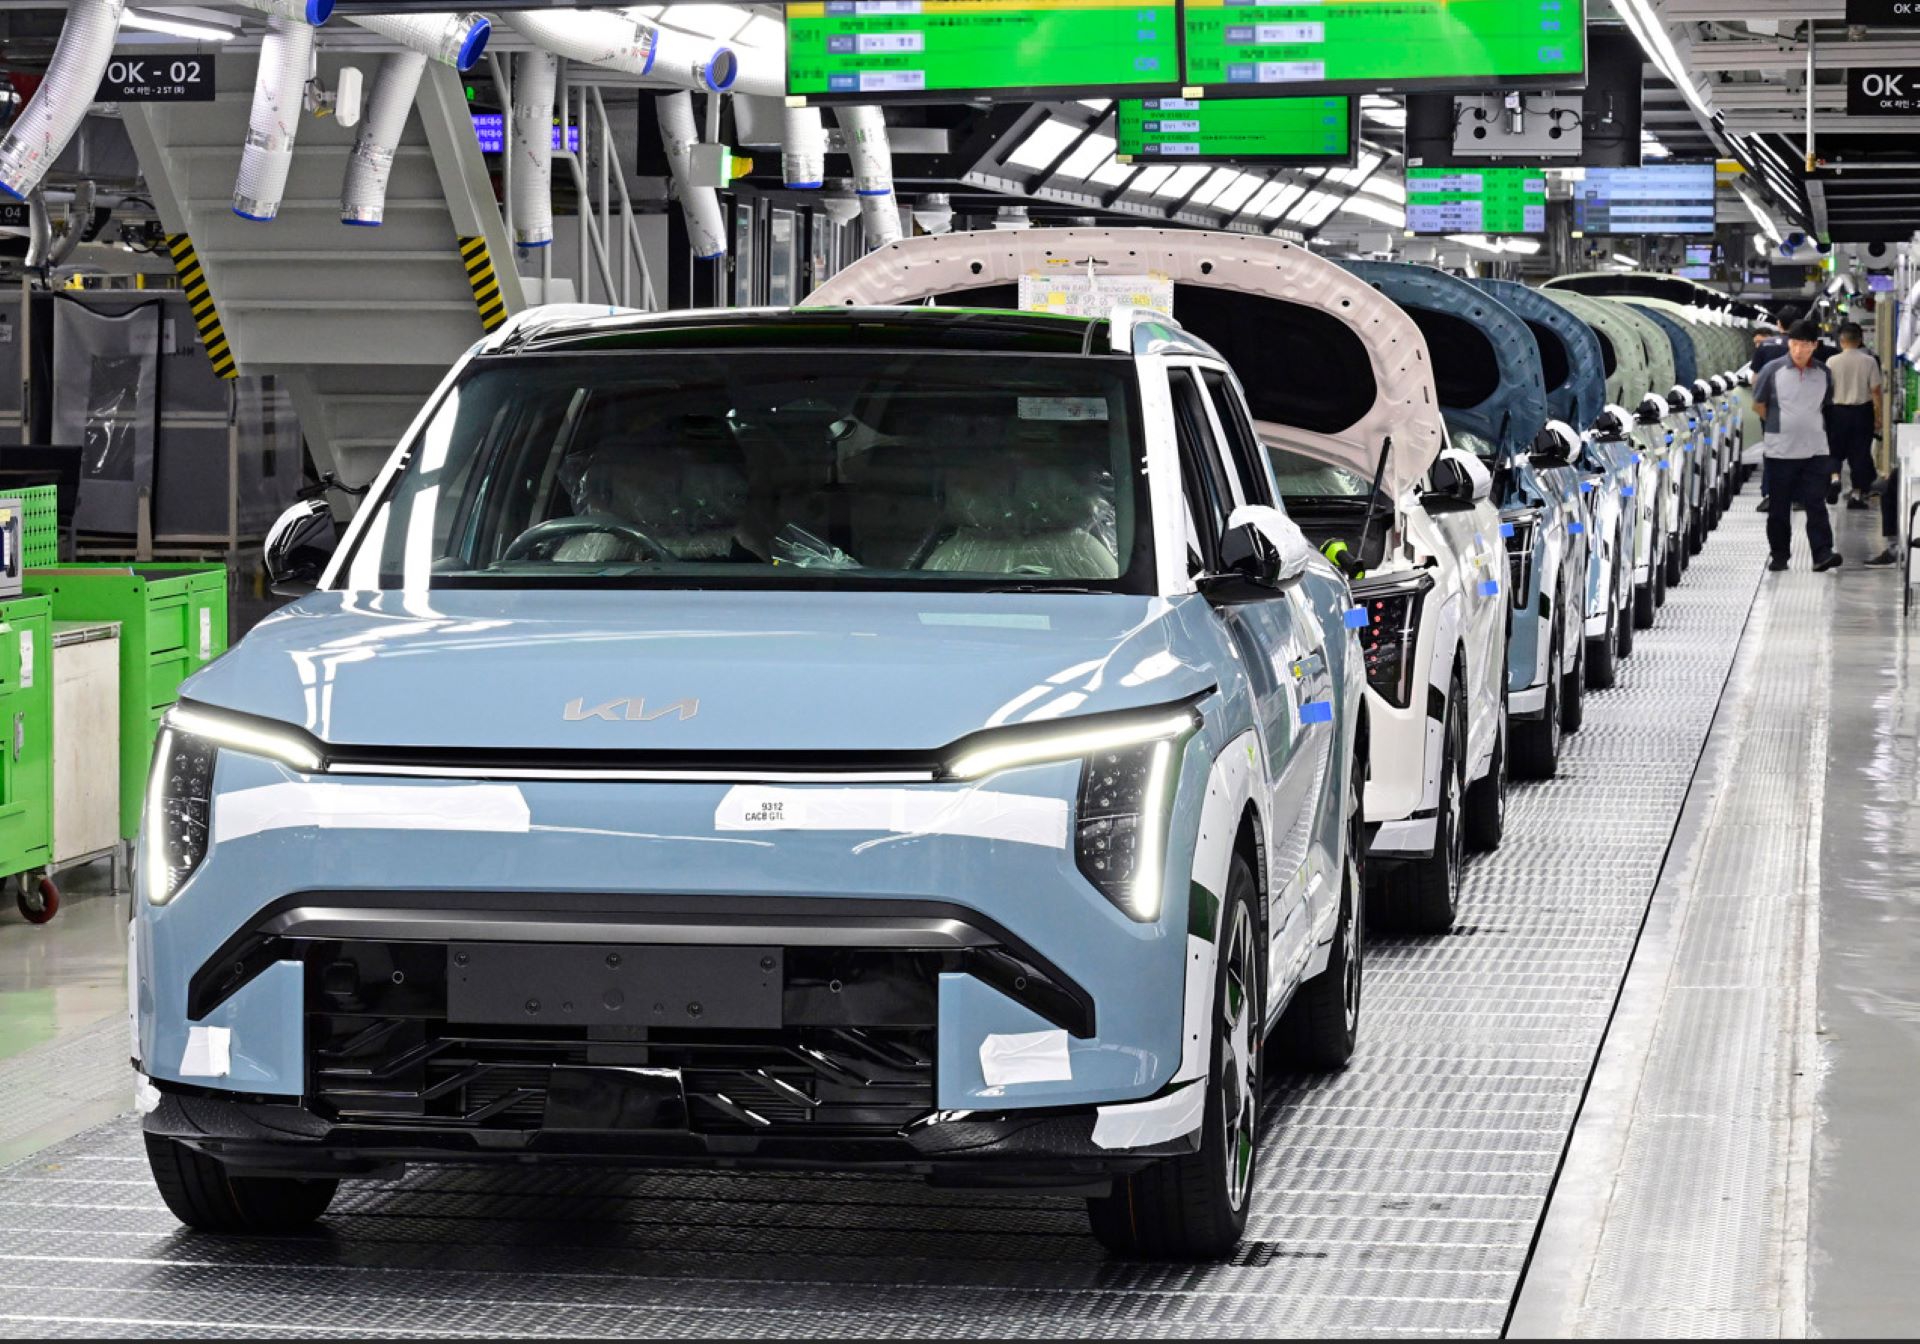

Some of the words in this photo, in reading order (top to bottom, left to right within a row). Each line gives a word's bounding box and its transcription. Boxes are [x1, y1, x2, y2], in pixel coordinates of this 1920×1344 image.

[1893, 3, 1911, 14] OK
[107, 61, 145, 83] OK
[169, 61, 201, 83] 02
[123, 86, 135, 95] OK
[1862, 74, 1904, 97] OK
[1880, 100, 1893, 108] OK
[1894, 99, 1910, 109] 라인
[5, 207, 21, 218] 04
[563, 696, 700, 721] KIA
[761, 802, 784, 811] 9312
